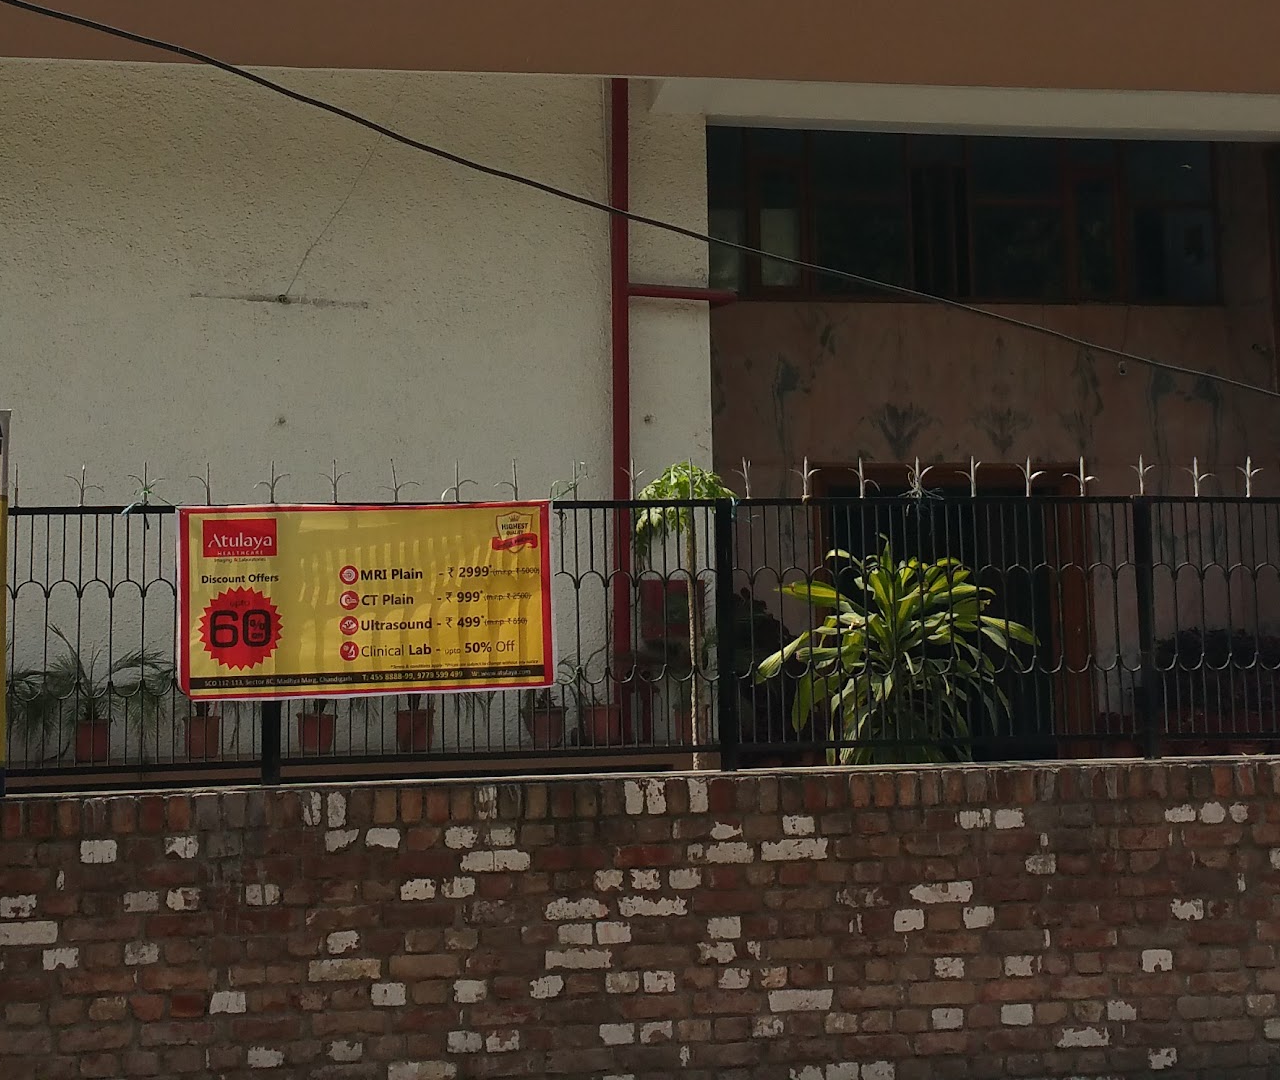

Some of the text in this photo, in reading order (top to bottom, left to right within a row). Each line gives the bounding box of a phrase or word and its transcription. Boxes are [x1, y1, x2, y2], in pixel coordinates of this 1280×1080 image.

[208, 532, 272, 550] Atulaya
[201, 573, 279, 584] Discount Offers
[360, 569, 387, 581] MRI
[391, 567, 423, 580] Plain
[361, 594, 378, 606] CT
[382, 593, 414, 605] Plain
[210, 609, 271, 648] 60
[361, 618, 432, 631] Ultrasound
[361, 645, 404, 657] Clinical
[409, 644, 432, 656] Lab
[464, 642, 492, 654] 50%
[496, 640, 515, 652] Off
